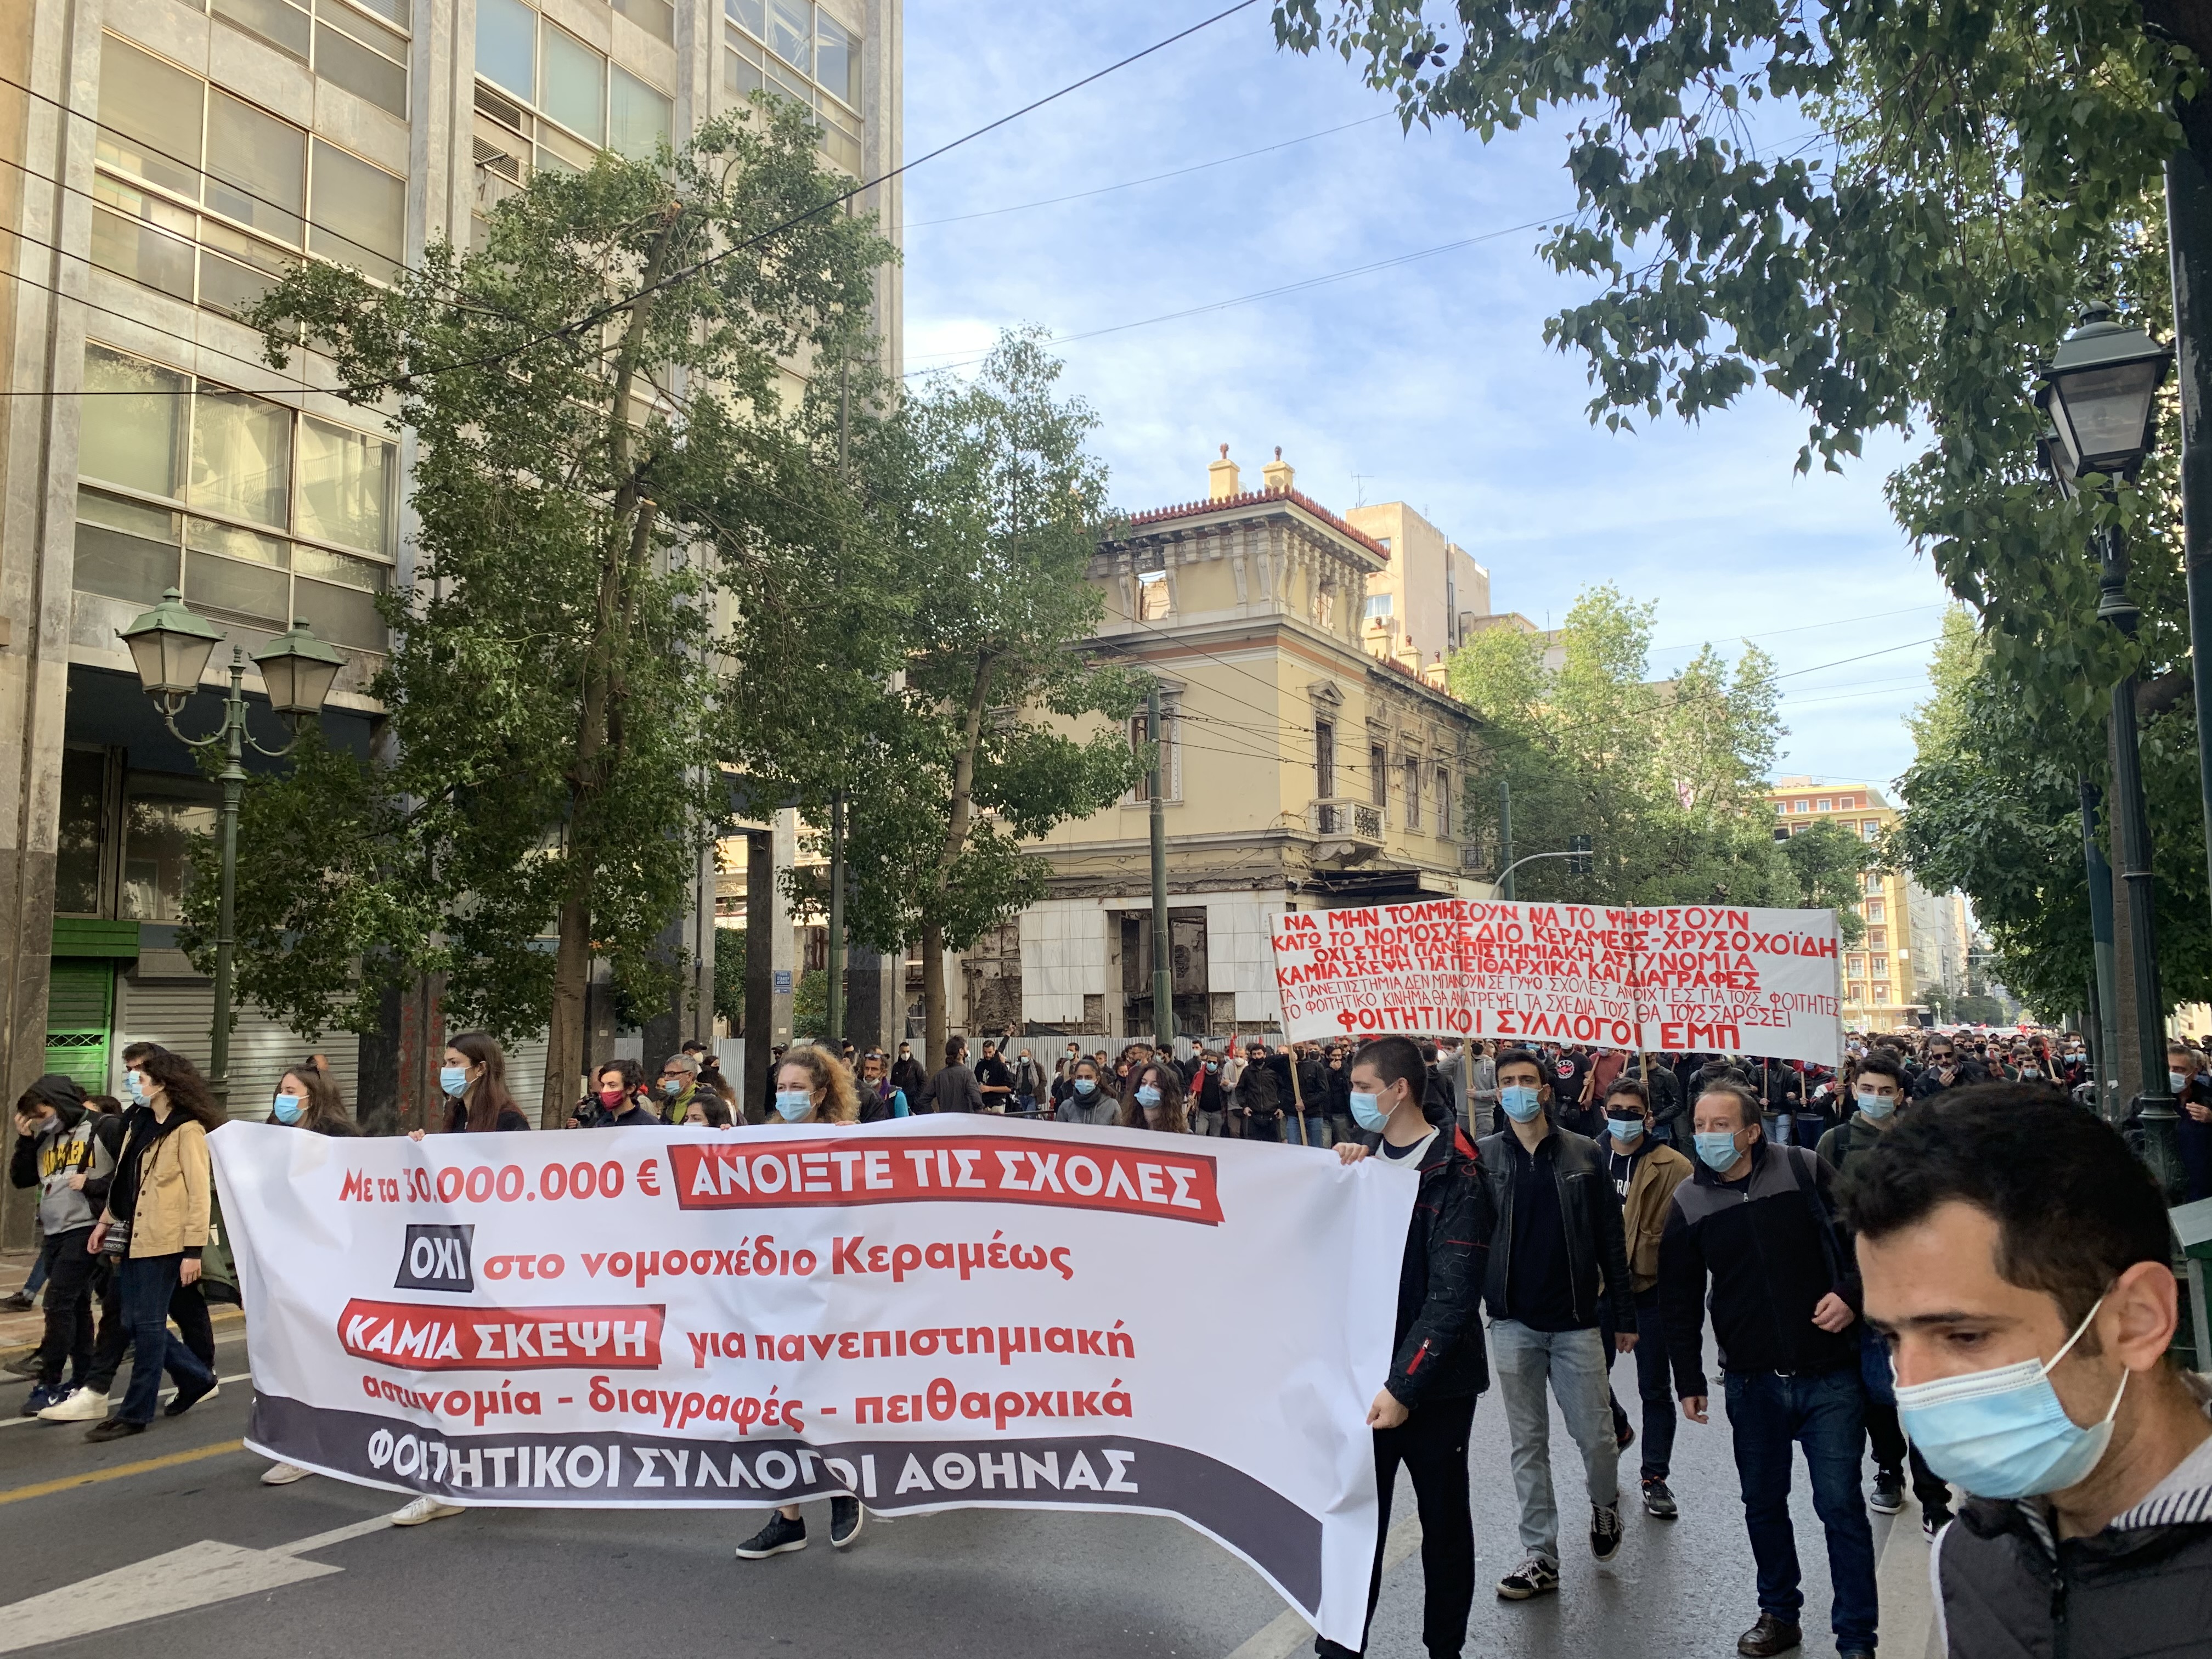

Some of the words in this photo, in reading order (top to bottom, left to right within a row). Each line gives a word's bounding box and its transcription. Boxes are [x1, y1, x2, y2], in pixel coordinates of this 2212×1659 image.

[1284, 915, 1317, 930] ΝΑ
[1329, 909, 1380, 929] ΜΗΝ
[1385, 900, 1519, 925] ΤΟΛΜΗΣΟΥΝ
[1529, 907, 1559, 927] ΝΑ
[1566, 907, 1595, 929] ΤΟ
[1605, 906, 1749, 930] ΨΗΦΙΣΟΥΝ
[1271, 932, 1322, 953] ΚΑΤΩ
[1329, 931, 1355, 946] ΤΟ
[1364, 922, 1523, 945] ΝΟΜΟΣΧΕΔΙΟ
[1314, 947, 1347, 963] ΟΧΙ
[1354, 943, 1408, 961] ΣΤΗΝ
[1414, 940, 1594, 962] ΠΑΝΕΠΙΣΤΗΜΙΑΚΗ
[1601, 946, 1757, 971] ΑΣΤΥΝΟΜΙΑ
[1276, 962, 1342, 988] ΚΑΜΙΑ
[1342, 958, 1413, 977] ΣΚΕΨΗ
[1417, 955, 1448, 971] ΓΙΑ
[1450, 955, 1582, 977] ΠΕΙΘΑΡΧΙΚΑ
[1588, 962, 1621, 983] ΚΑΙ
[1624, 969, 1761, 991] ΔΙΑΓΡΑΦΕΣ
[1279, 989, 1296, 1005] ΤΑ
[1299, 974, 1403, 999] ΠΑΝΕΠΙΣΤΗΜΙΑ
[1405, 974, 1430, 989] ΔΕΝ
[1488, 975, 1505, 990] ΣΕ
[1549, 977, 1610, 997] ΣΧΟΛΕΣ
[1616, 986, 1696, 1003] ΑΝΟΙΧΤΕΣ
[1701, 989, 1725, 1004] ΓΙΑ
[1726, 990, 1762, 1007] ΤΟΥΣ
[1770, 991, 1840, 1017] ΦΟΙΤΗΤΕΣ
[1281, 1003, 1301, 1022] ΤΟ
[1305, 992, 1376, 1015] ΦΟΙΤΗΤΙΚΟ
[1383, 990, 1431, 1007] ΚΙΝΗΜΑ
[1432, 990, 1449, 1006] ΘΑ
[1451, 990, 1518, 1010] ΑΝΑΤΡΕΨΕΙ
[1524, 994, 1542, 1011] ΤΑ
[1546, 994, 1597, 1016] ΣΧΕΔΙΑ
[1637, 1003, 1661, 1023] ΘΑ
[1666, 1003, 1706, 1023] ΤΟΥΣ
[1337, 1006, 1481, 1034] ΦΟΙΤΗΤΙΚΟΙ
[1497, 1009, 1642, 1047] ΣΥΛΛΟΓΟΙ
[1661, 1023, 1740, 1049] ΕΜΠ
[339, 1167, 373, 1203] Με
[379, 1178, 400, 1203] τα
[402, 1159, 624, 1204] 30.000.000
[636, 1159, 661, 1197] €
[691, 1150, 893, 1196] ΑΝΟΙΞΤΕ
[903, 1148, 986, 1189] ΤΙΣ
[995, 1150, 1201, 1210] ΣΧΟΛΕΣ
[410, 1235, 466, 1281] ΟΧΙ
[483, 1252, 566, 1281] στο
[580, 1234, 817, 1288] νομοσχέδιο
[832, 1229, 1074, 1283] Κεραμέως
[345, 1314, 462, 1361] ΚΑΜΙΑ
[473, 1320, 647, 1361] ΣΚΕΨΗ
[687, 1331, 746, 1369] για
[755, 1318, 1135, 1365] πανεπιστημιακή
[363, 1374, 541, 1427] αστυνομία
[588, 1375, 804, 1436] διαγραφές
[855, 1377, 1133, 1430] πειθαρχικά
[368, 1428, 620, 1488] ΦΟΙΤΗΤΙΚΟΙ
[633, 1447, 877, 1498] ΣΥΛΛΟΓΟΙ
[895, 1449, 1138, 1496] ΑΘΗΝΑΣ
